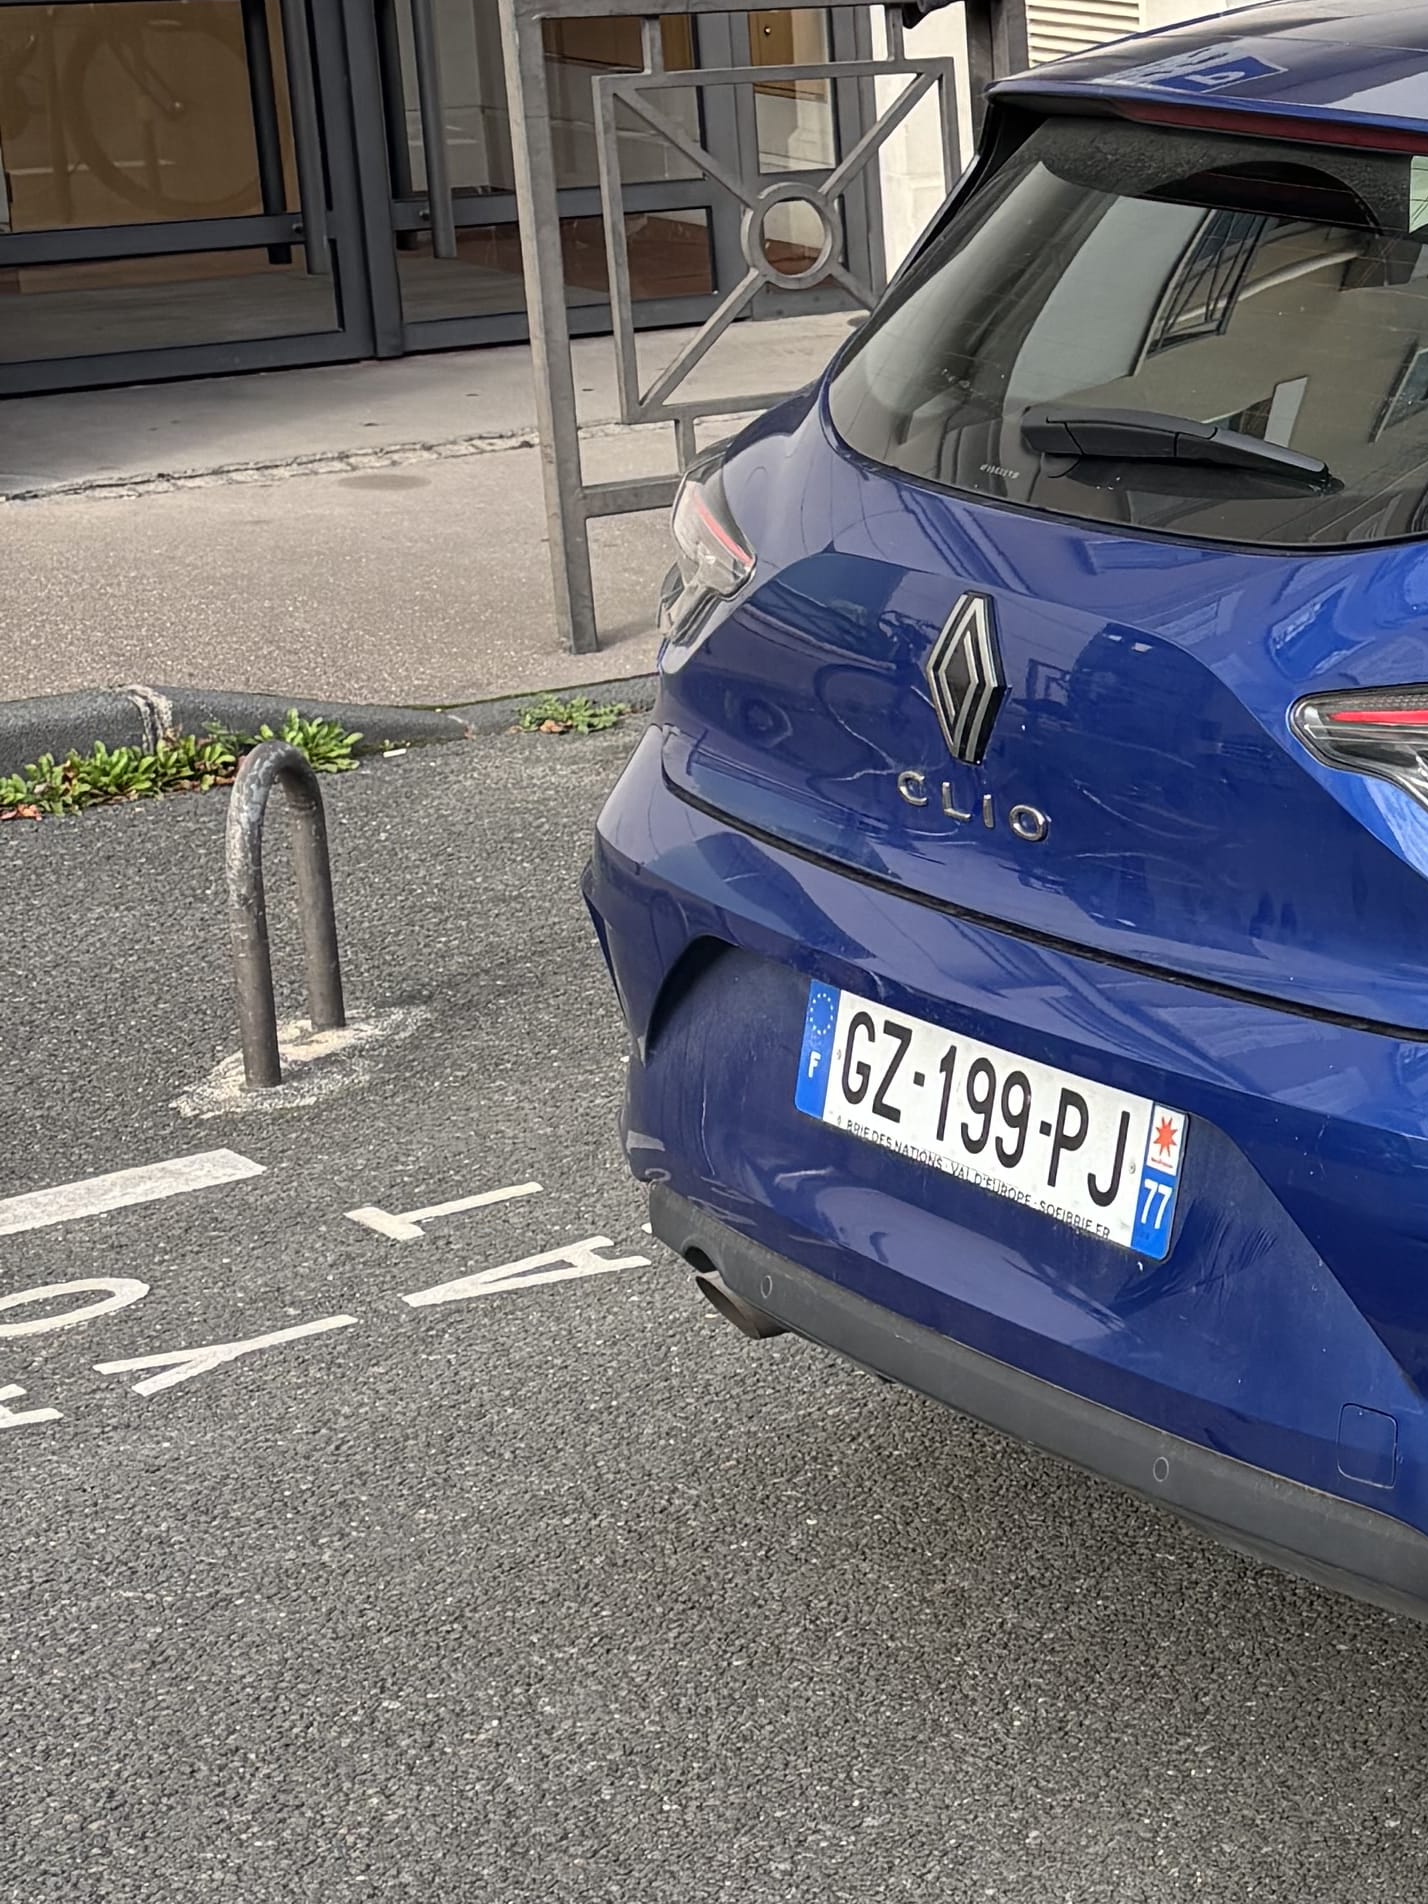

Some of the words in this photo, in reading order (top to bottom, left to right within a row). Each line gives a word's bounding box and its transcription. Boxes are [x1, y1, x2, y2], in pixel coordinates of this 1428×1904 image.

[897, 770, 1049, 842] CLIO
[807, 1050, 822, 1079] F
[842, 1011, 1130, 1207] GZ-199-PJ
[1141, 1178, 1173, 1230] 77
